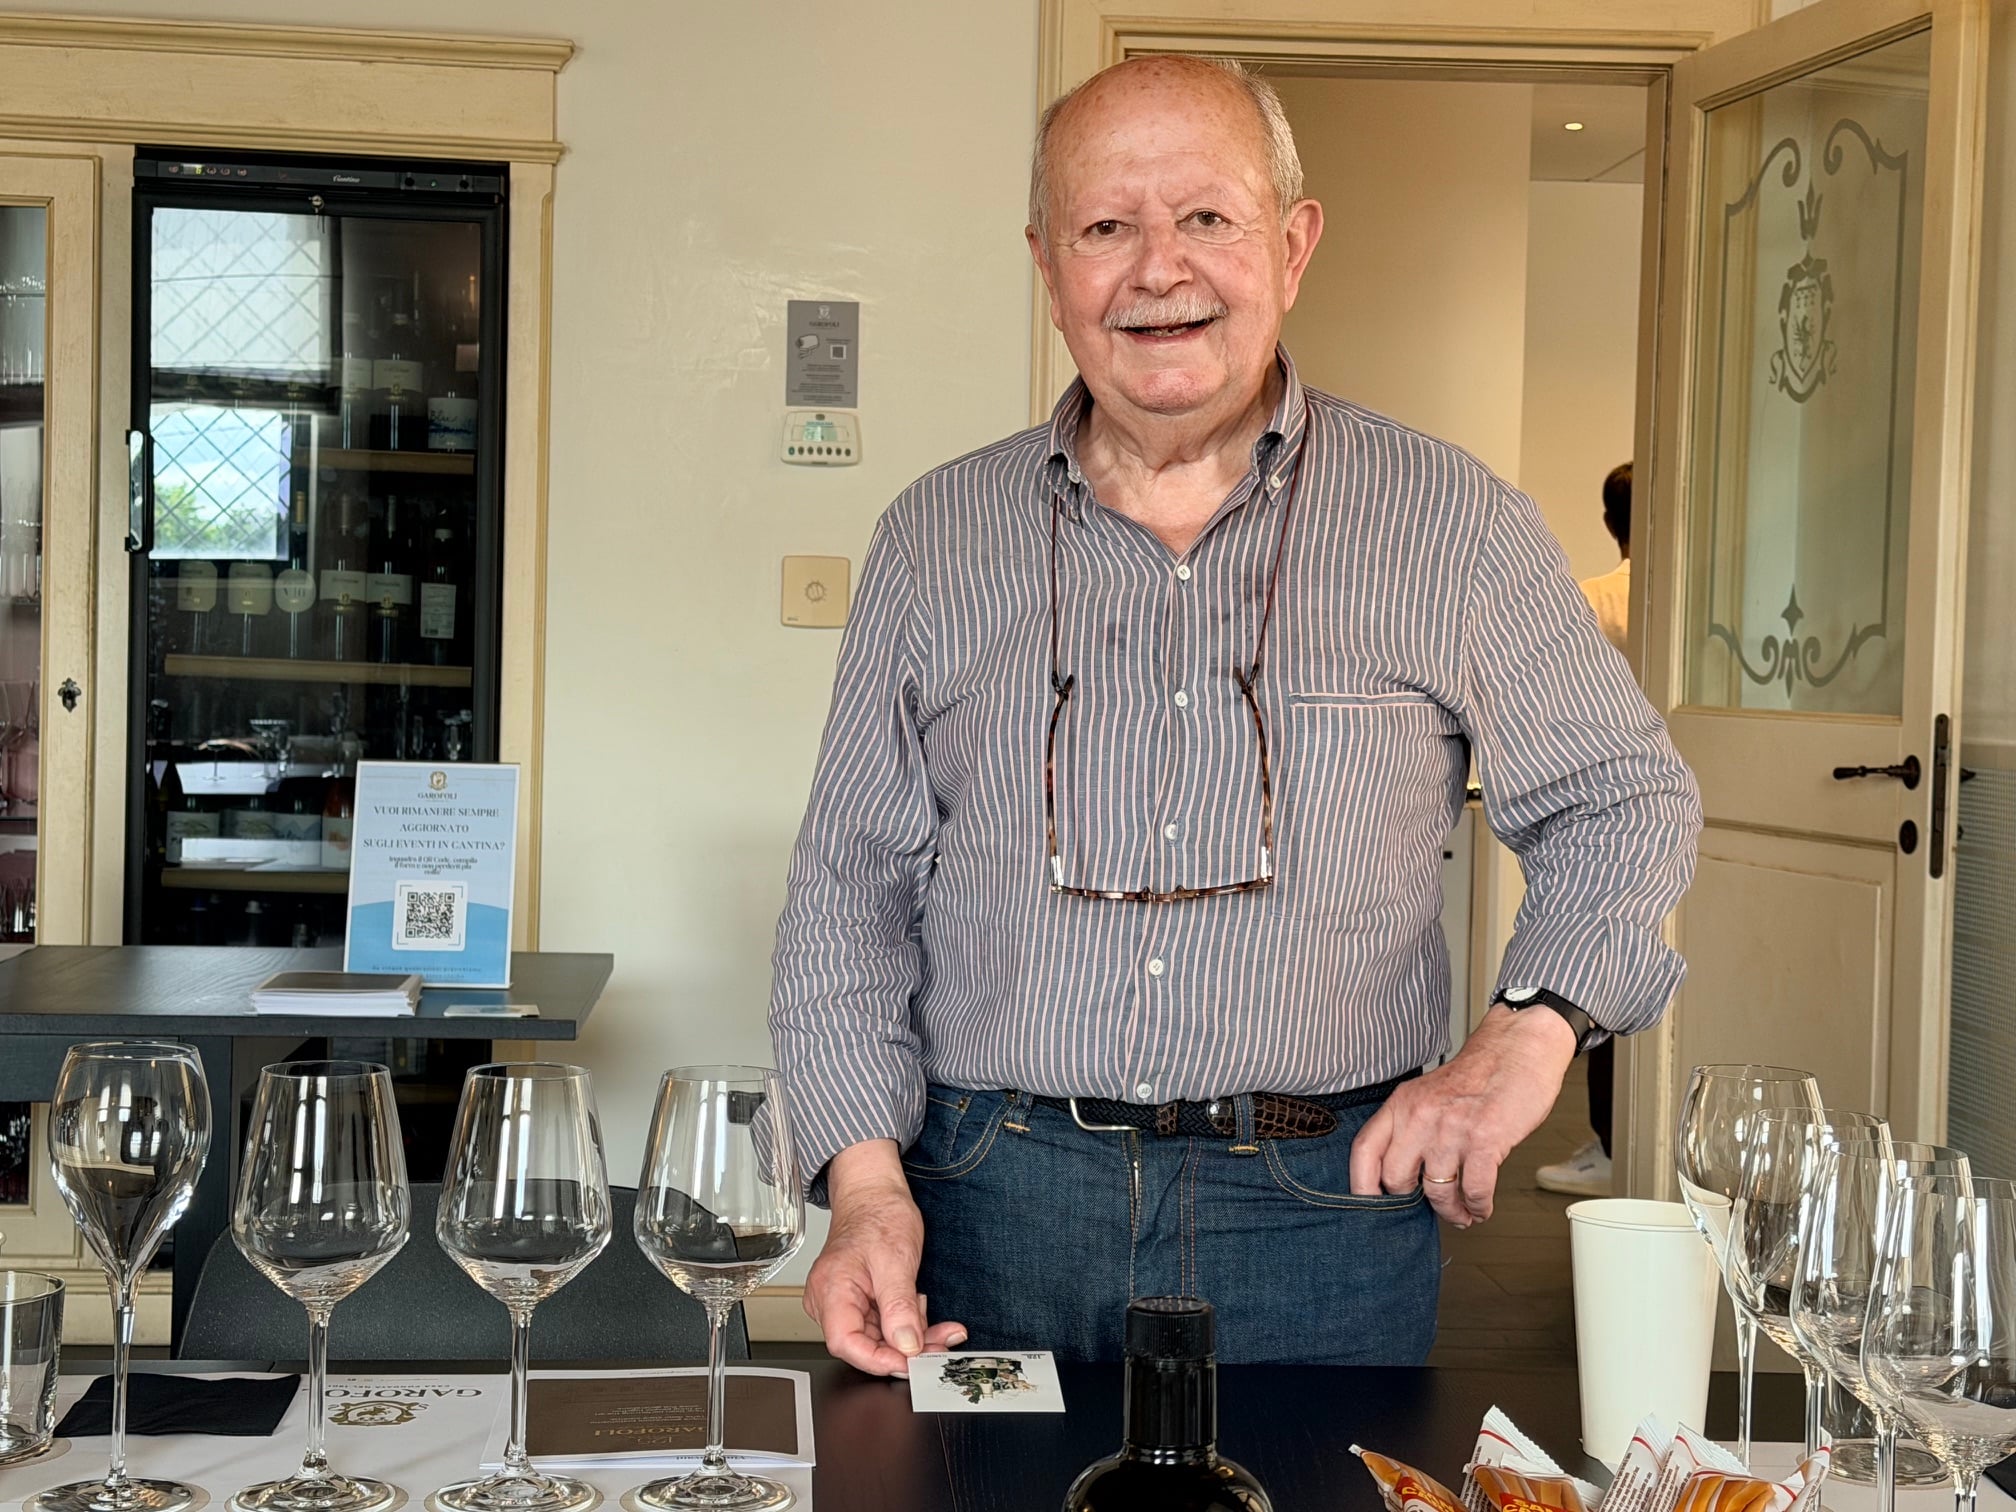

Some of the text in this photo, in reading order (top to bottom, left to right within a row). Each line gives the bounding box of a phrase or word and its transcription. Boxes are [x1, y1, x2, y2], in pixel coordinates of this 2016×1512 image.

[417, 792, 458, 800] GAROFOLI
[374, 805, 500, 818] VUOI RIMANERE SEMPRE
[399, 823, 470, 833] AGGIORNATO
[362, 838, 506, 851] SUGLI EVENTI IN CANTINA?
[301, 1388, 483, 1399] GAROFO
